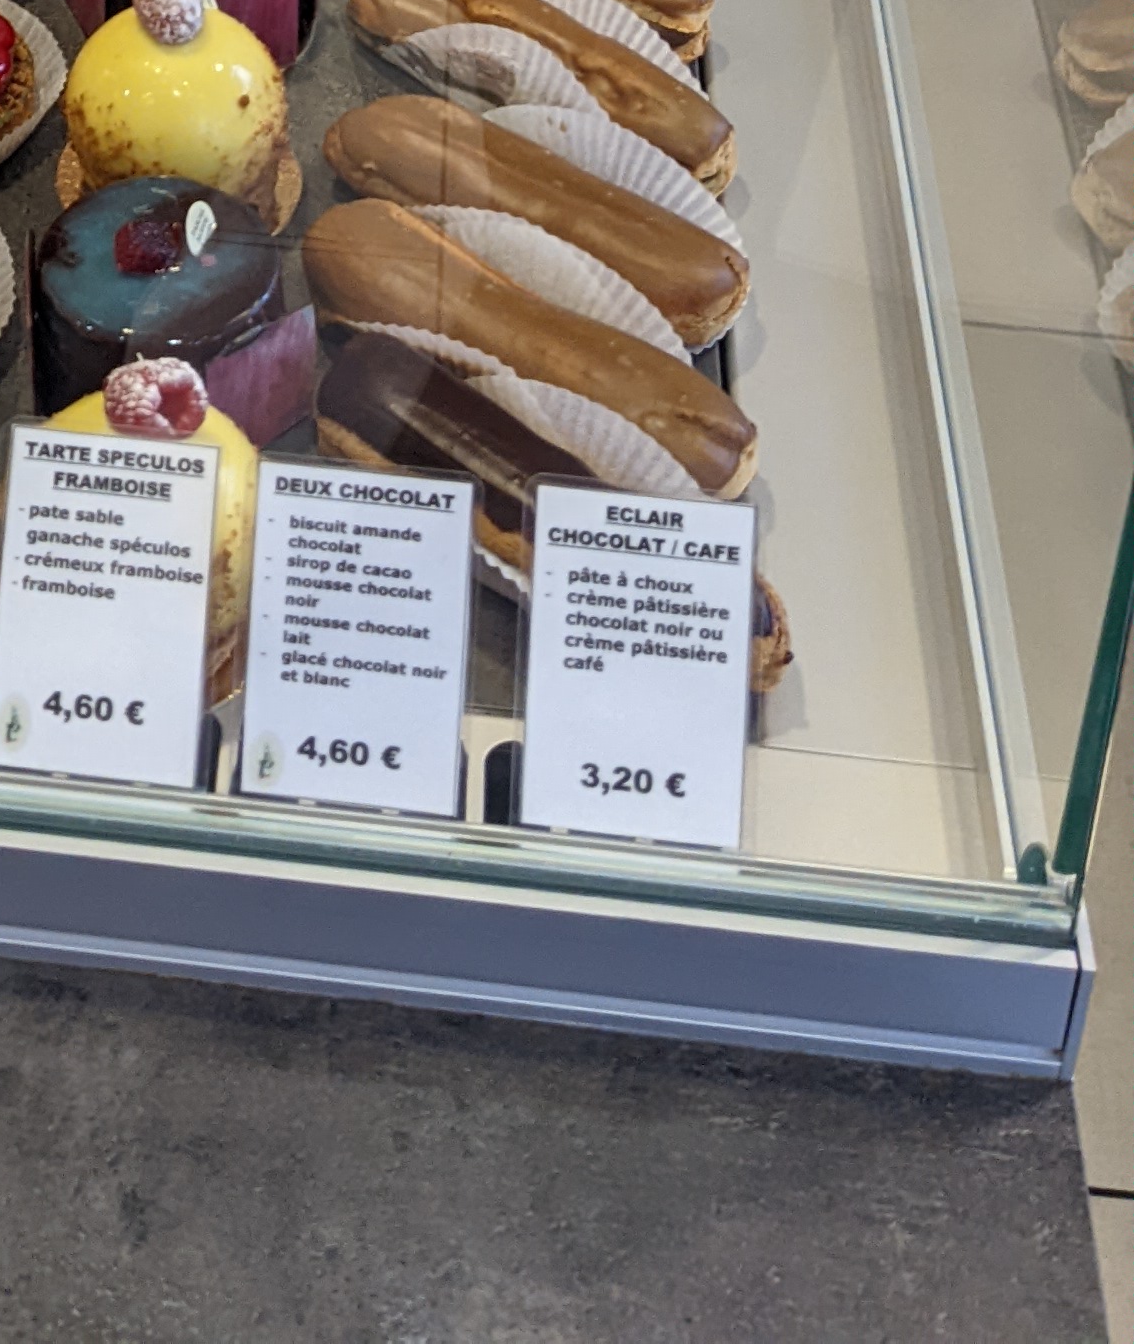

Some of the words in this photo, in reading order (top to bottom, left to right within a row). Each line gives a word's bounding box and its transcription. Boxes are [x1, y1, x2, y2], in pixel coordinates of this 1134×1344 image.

[24, 440, 92, 463] TARTE
[97, 448, 205, 474] SPECULOS
[52, 470, 172, 498] FRAMBOISE
[274, 475, 333, 497] DEUX
[338, 482, 456, 509] CHOCOLAT
[27, 504, 70, 521] pate
[605, 504, 684, 528] ECLAIR
[288, 516, 348, 535] biscuit
[351, 523, 422, 543] amande
[25, 528, 105, 549] ganache
[109, 537, 191, 559] spéculos
[287, 536, 363, 556] chocolat
[547, 526, 666, 554] CHOCOLAT
[682, 540, 740, 562] CAFE
[23, 553, 104, 573] crémeux
[109, 560, 204, 585] framboise
[286, 555, 332, 573] sirop
[335, 559, 358, 574] de
[361, 564, 413, 580] cacao
[21, 576, 116, 600] framboise
[285, 575, 353, 593] mousse
[356, 581, 432, 602] chocolat
[567, 568, 611, 586] pâte
[615, 572, 629, 588] à
[633, 575, 693, 595] choux
[284, 594, 321, 609] noir
[566, 591, 628, 610] crème
[632, 597, 730, 621] pâtissière
[282, 631, 311, 646] lait
[283, 613, 351, 631] mousse
[354, 619, 431, 640] chocolat
[564, 611, 649, 634] chocolat
[653, 621, 694, 638] noir
[698, 626, 723, 642] ou
[563, 634, 625, 653] crème
[630, 640, 728, 664] pâtissière
[280, 650, 328, 667] glacé
[331, 655, 407, 676] chocolat
[410, 665, 447, 680] noir
[562, 656, 605, 673] café
[279, 669, 299, 683] et
[302, 670, 351, 689] blanc
[41, 689, 114, 722] 4,60
[123, 699, 145, 726] €
[296, 734, 370, 767] 4,60
[379, 744, 401, 770] €
[580, 761, 654, 795] 3,20
[664, 771, 686, 799] €
